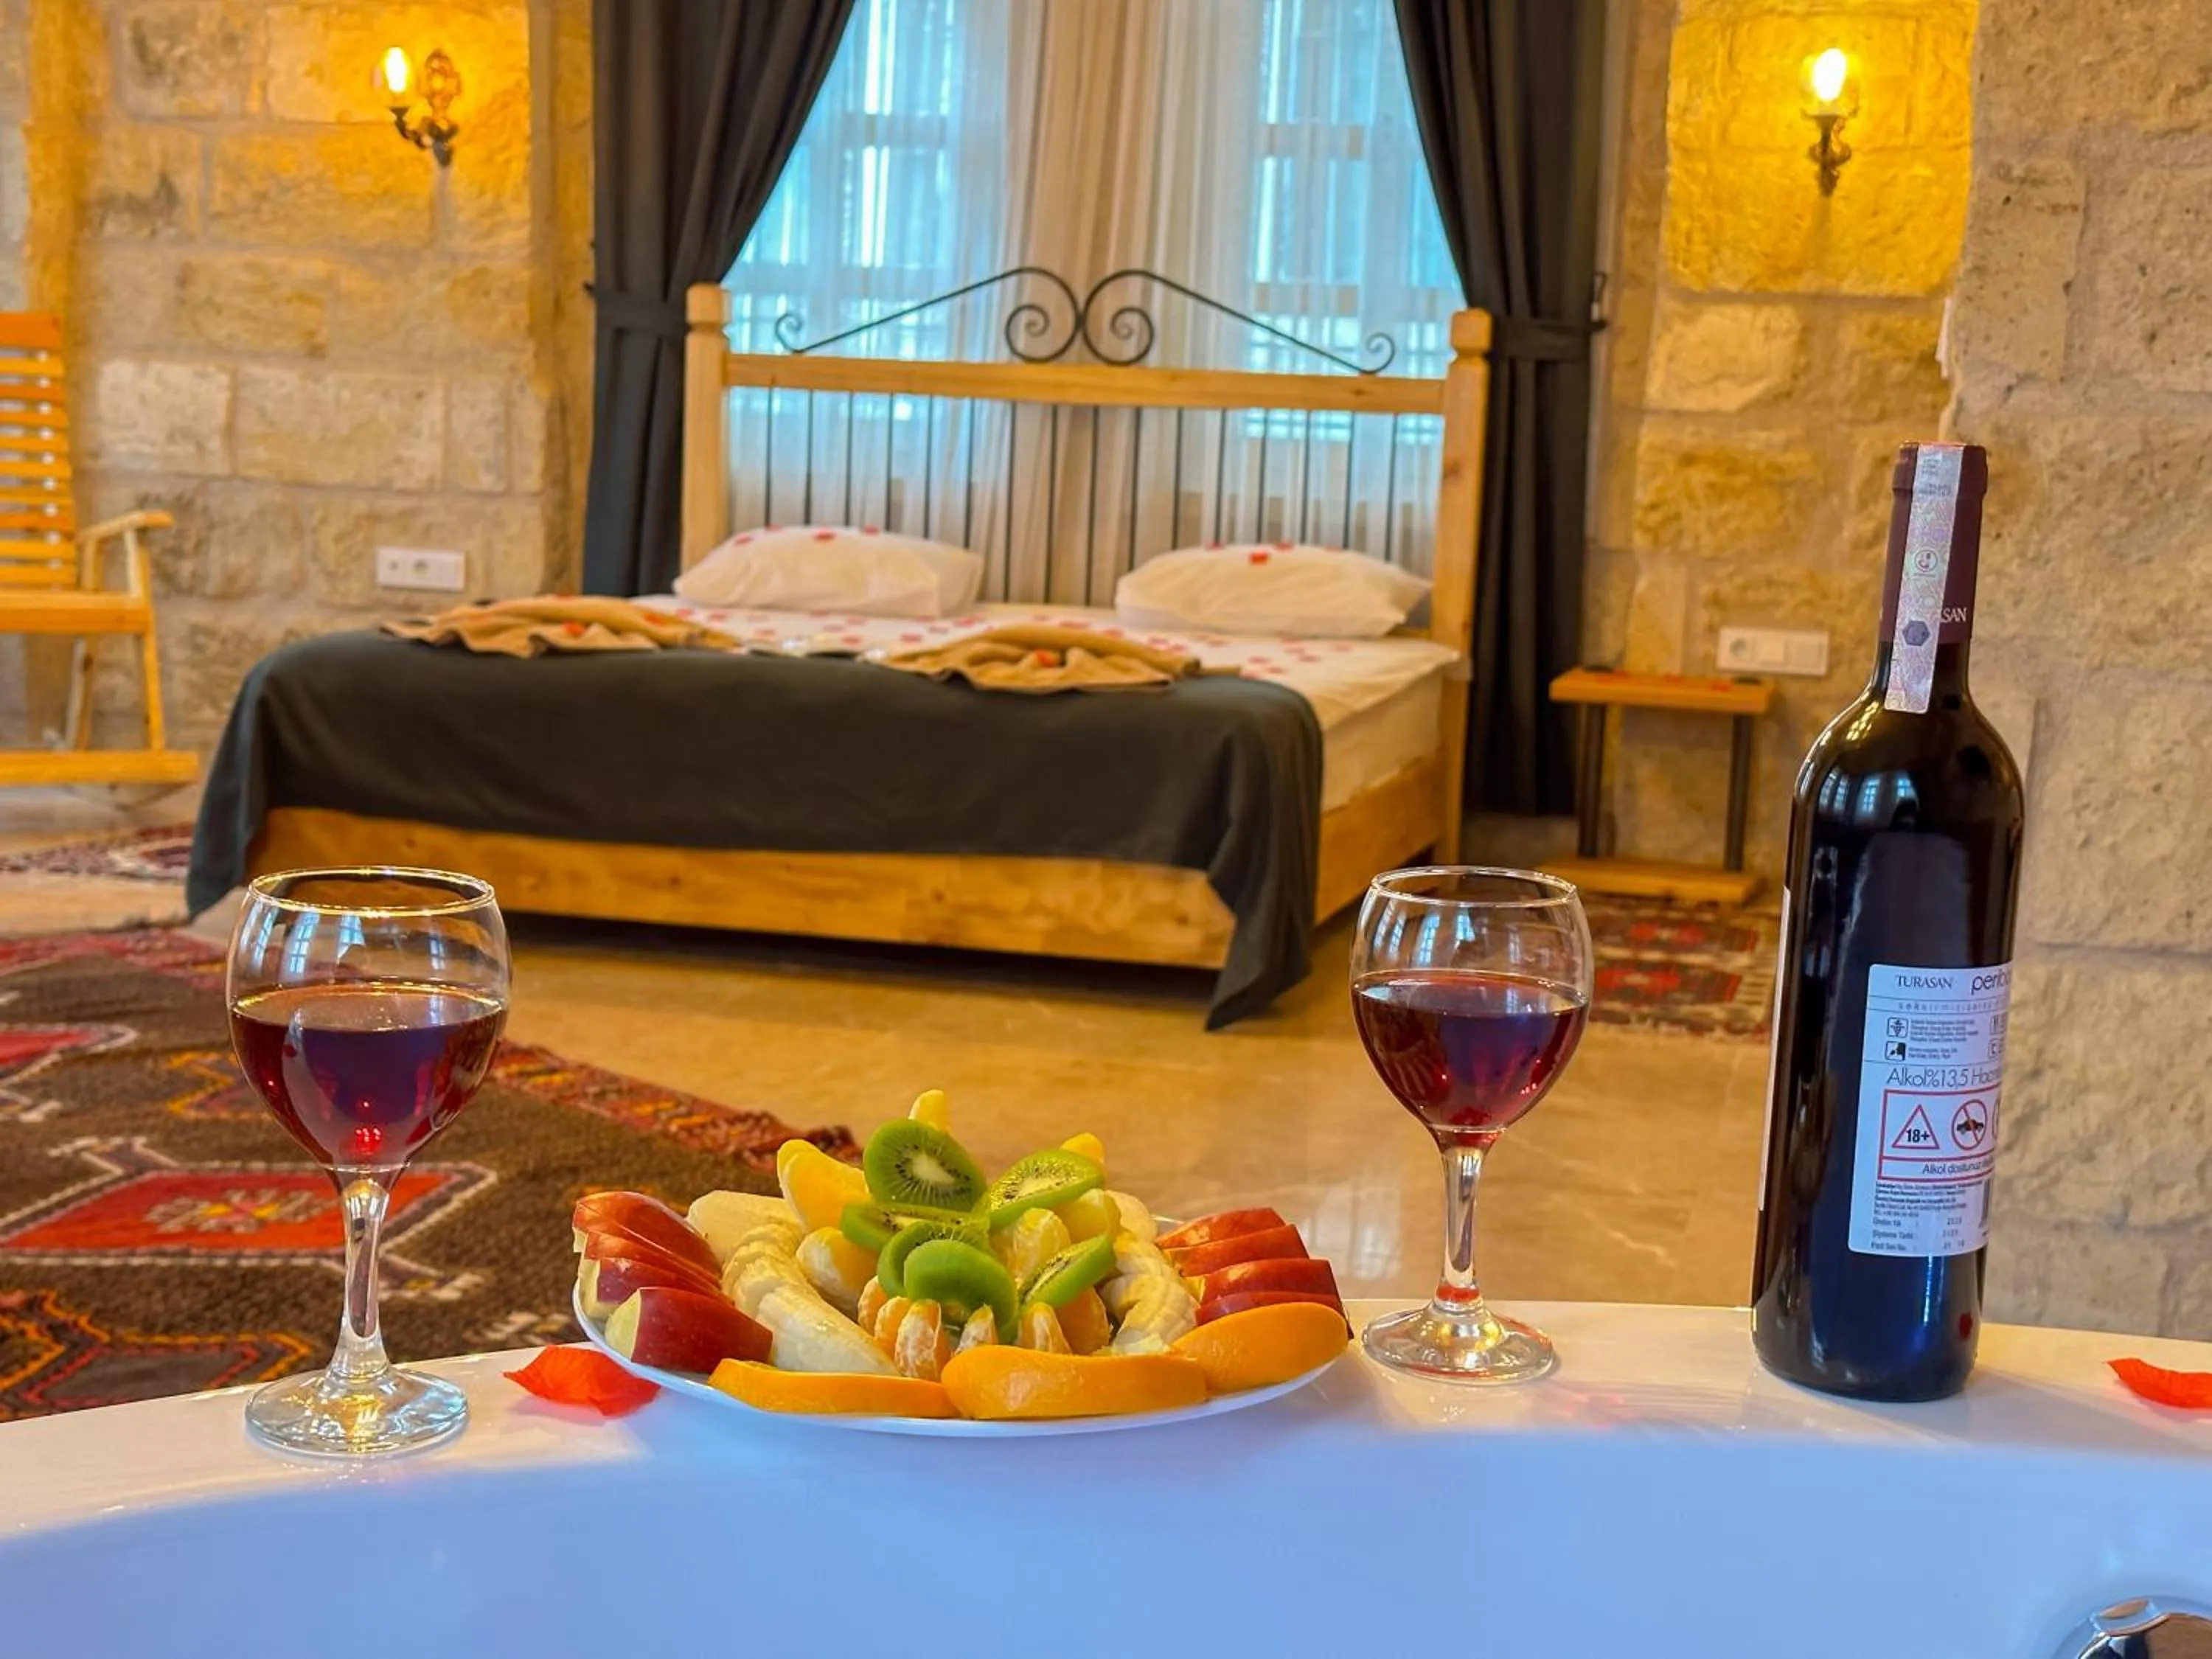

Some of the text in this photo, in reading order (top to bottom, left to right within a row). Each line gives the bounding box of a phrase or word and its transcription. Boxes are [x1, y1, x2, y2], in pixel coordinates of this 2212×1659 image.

[1896, 975, 1953, 990] TURASAN
[1906, 1128, 1930, 1143] 18+
[1922, 1163, 1947, 1175] Alkol
